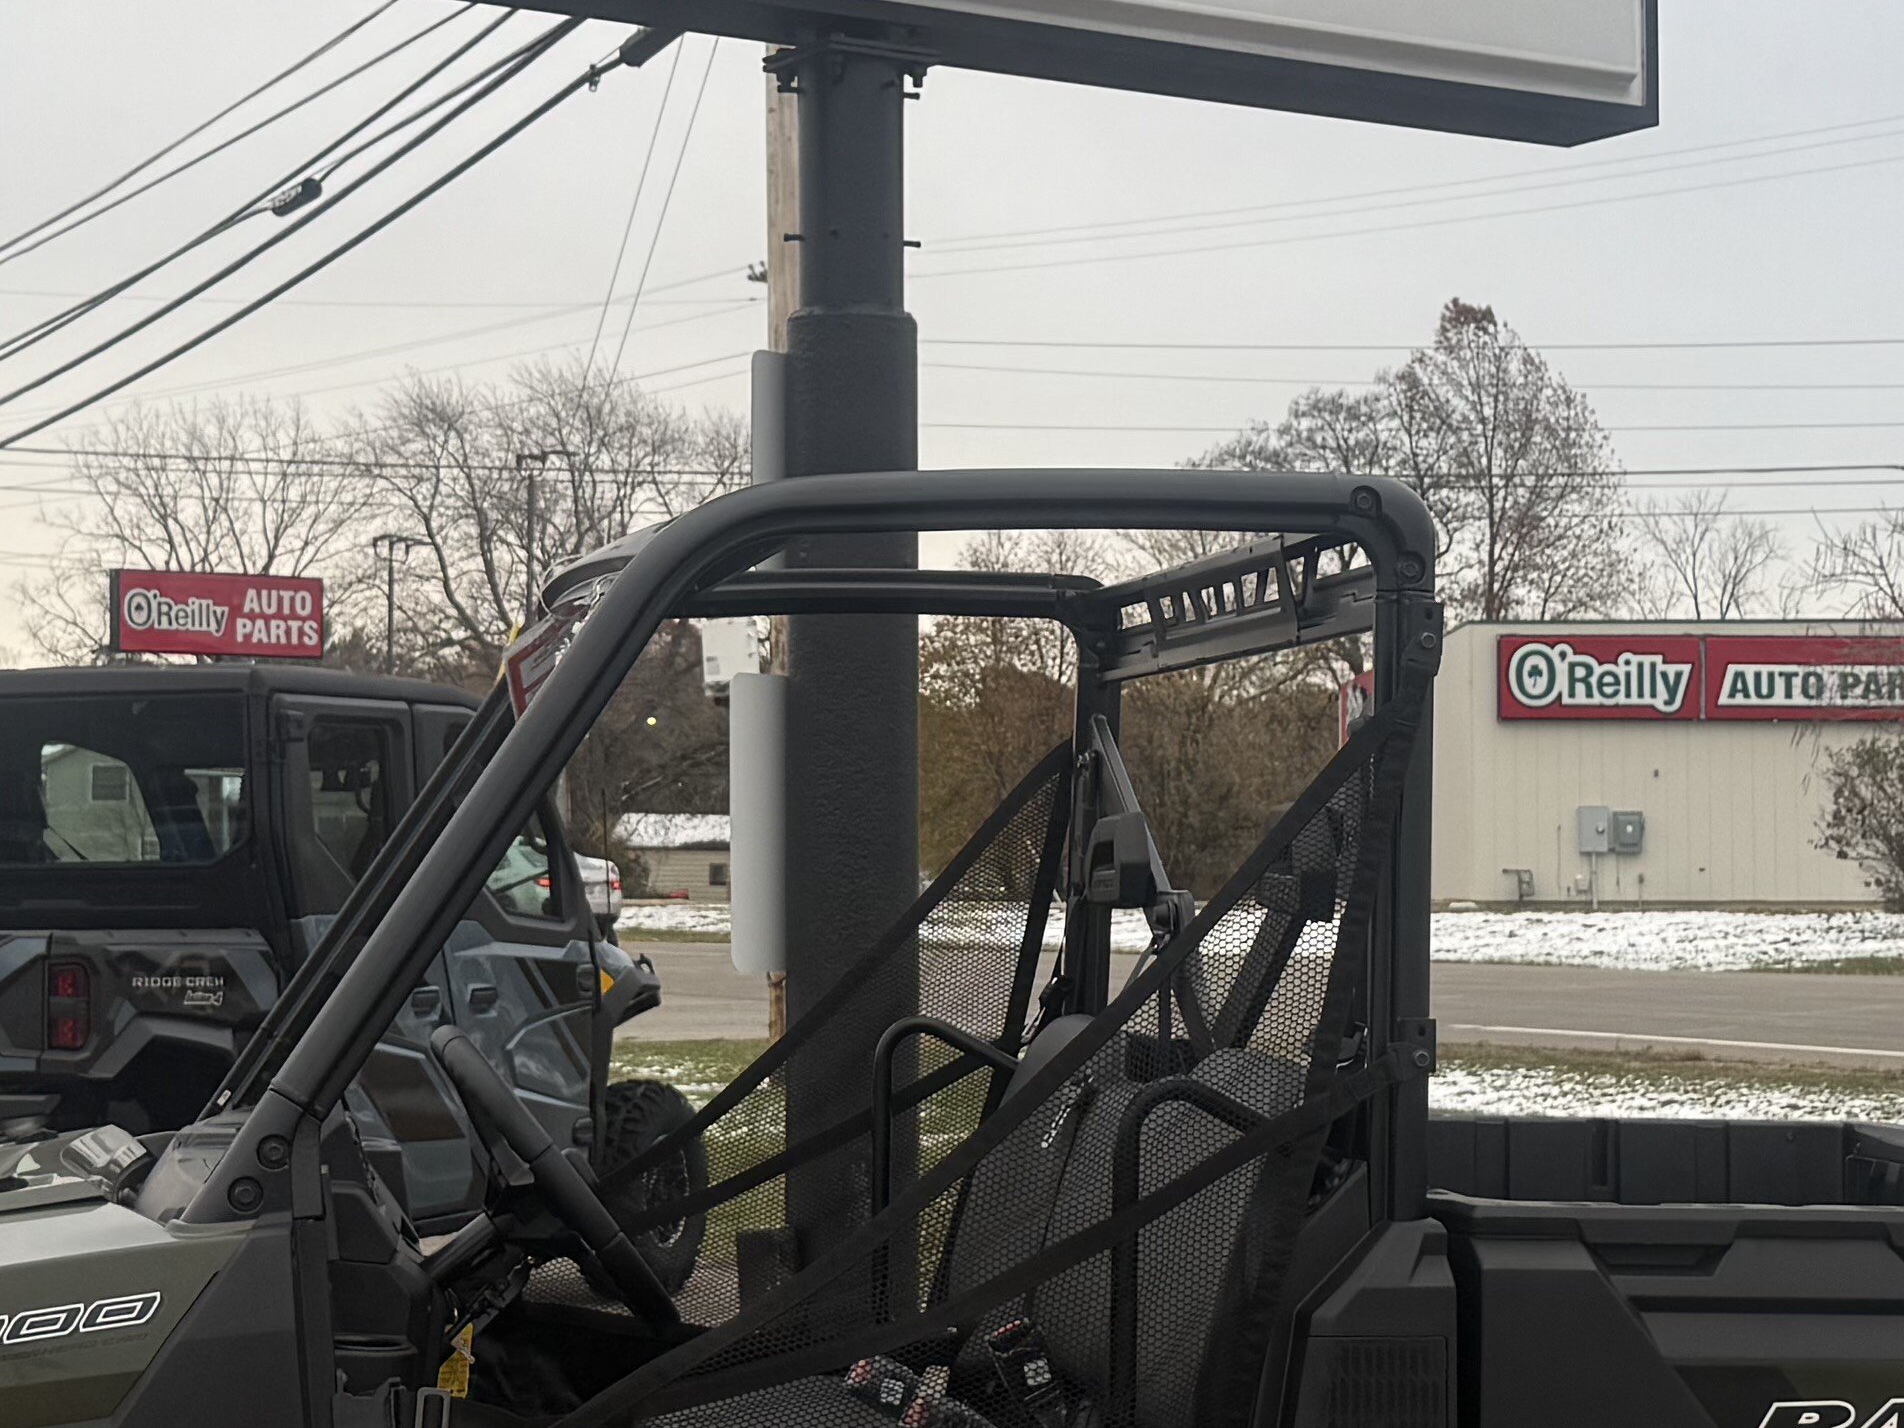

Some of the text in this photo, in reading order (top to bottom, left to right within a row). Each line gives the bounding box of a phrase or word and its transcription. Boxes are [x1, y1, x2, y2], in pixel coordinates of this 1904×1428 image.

[124, 588, 227, 637] O'Reilly
[243, 588, 312, 617] AUTO
[236, 618, 320, 645] PARTS
[1510, 644, 1692, 711] O'Reilly
[1727, 670, 1823, 700] AUTO
[132, 976, 181, 987] RIDGE
